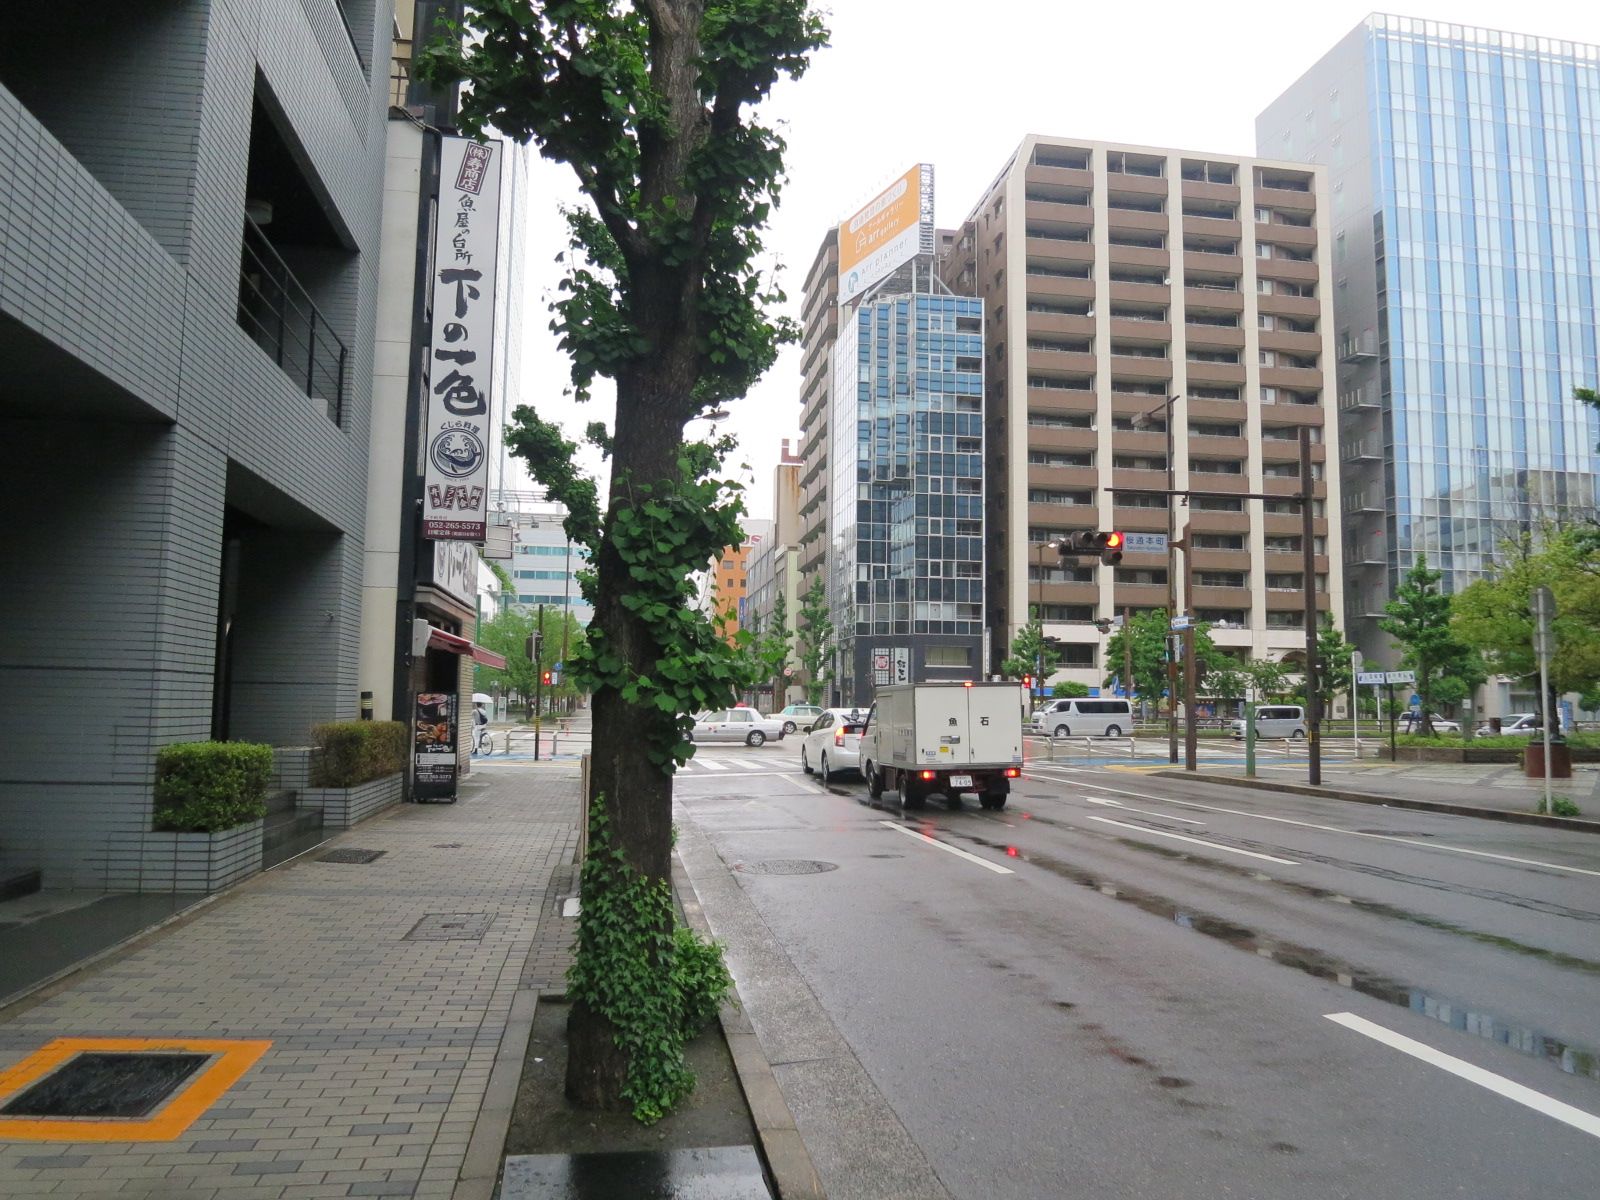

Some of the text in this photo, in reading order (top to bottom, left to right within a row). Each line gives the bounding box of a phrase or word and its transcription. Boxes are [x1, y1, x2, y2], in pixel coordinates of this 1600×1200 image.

[453, 194, 477, 265] 魚屋の台所
[434, 268, 487, 417] 下の一色
[428, 521, 481, 530] 052-265-5573
